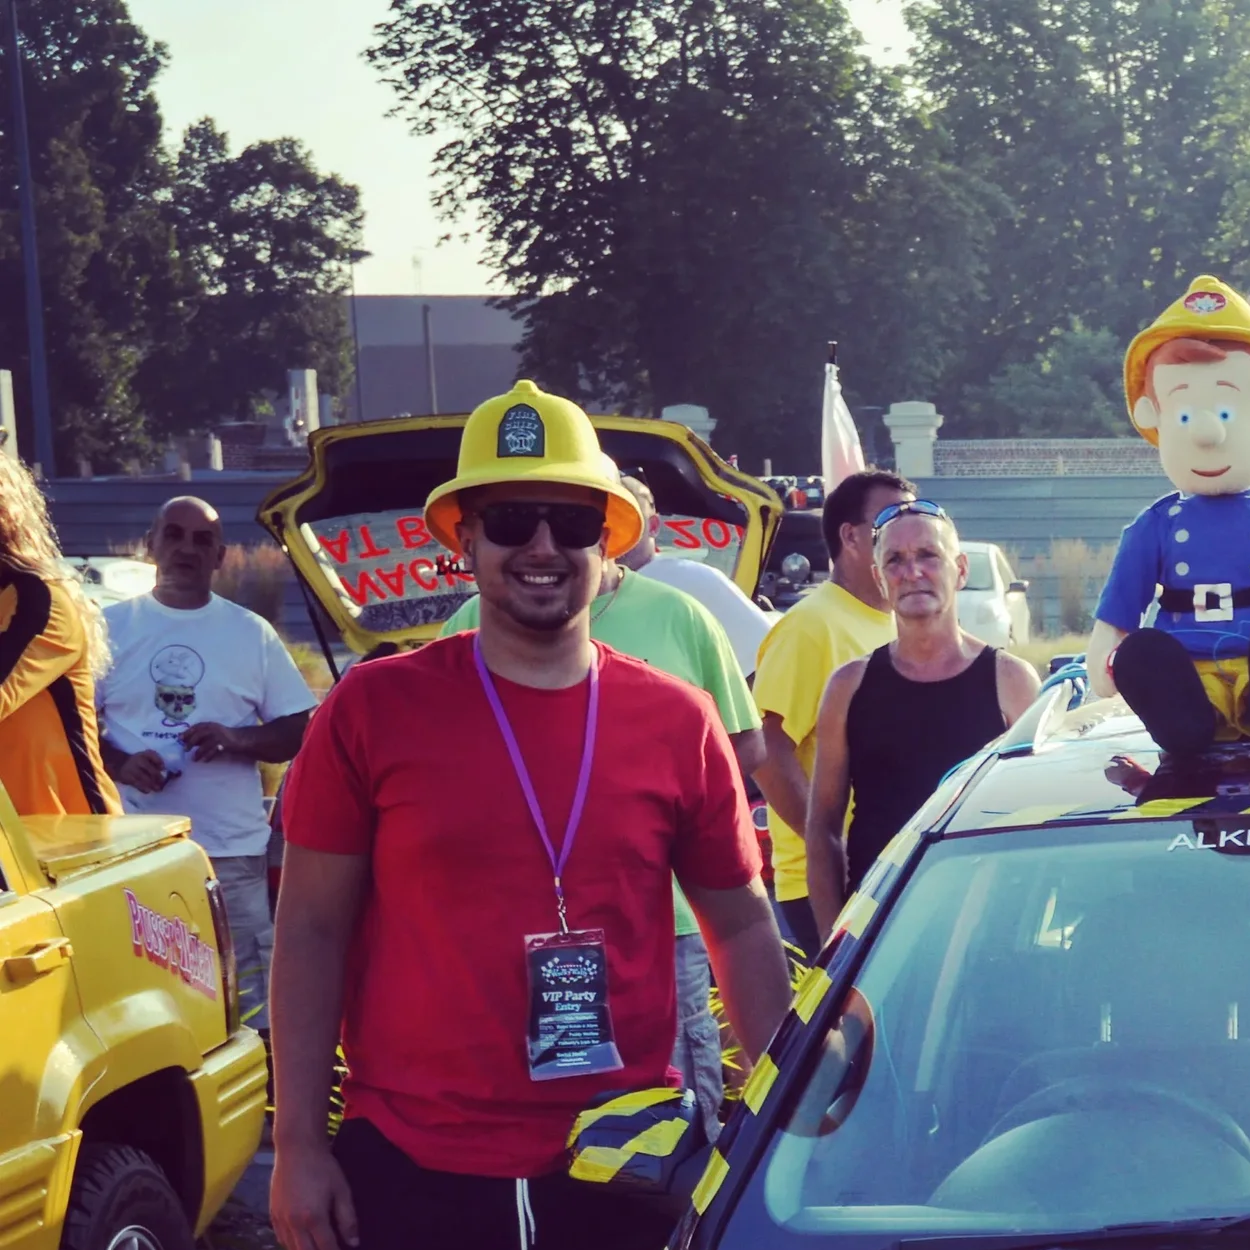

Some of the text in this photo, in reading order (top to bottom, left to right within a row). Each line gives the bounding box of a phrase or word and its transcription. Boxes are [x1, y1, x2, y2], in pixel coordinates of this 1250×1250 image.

[509, 411, 537, 420] FIRE
[505, 421, 538, 431] CHIEF
[542, 990, 597, 1003] VIP Party
[555, 1002, 582, 1012] Entry
